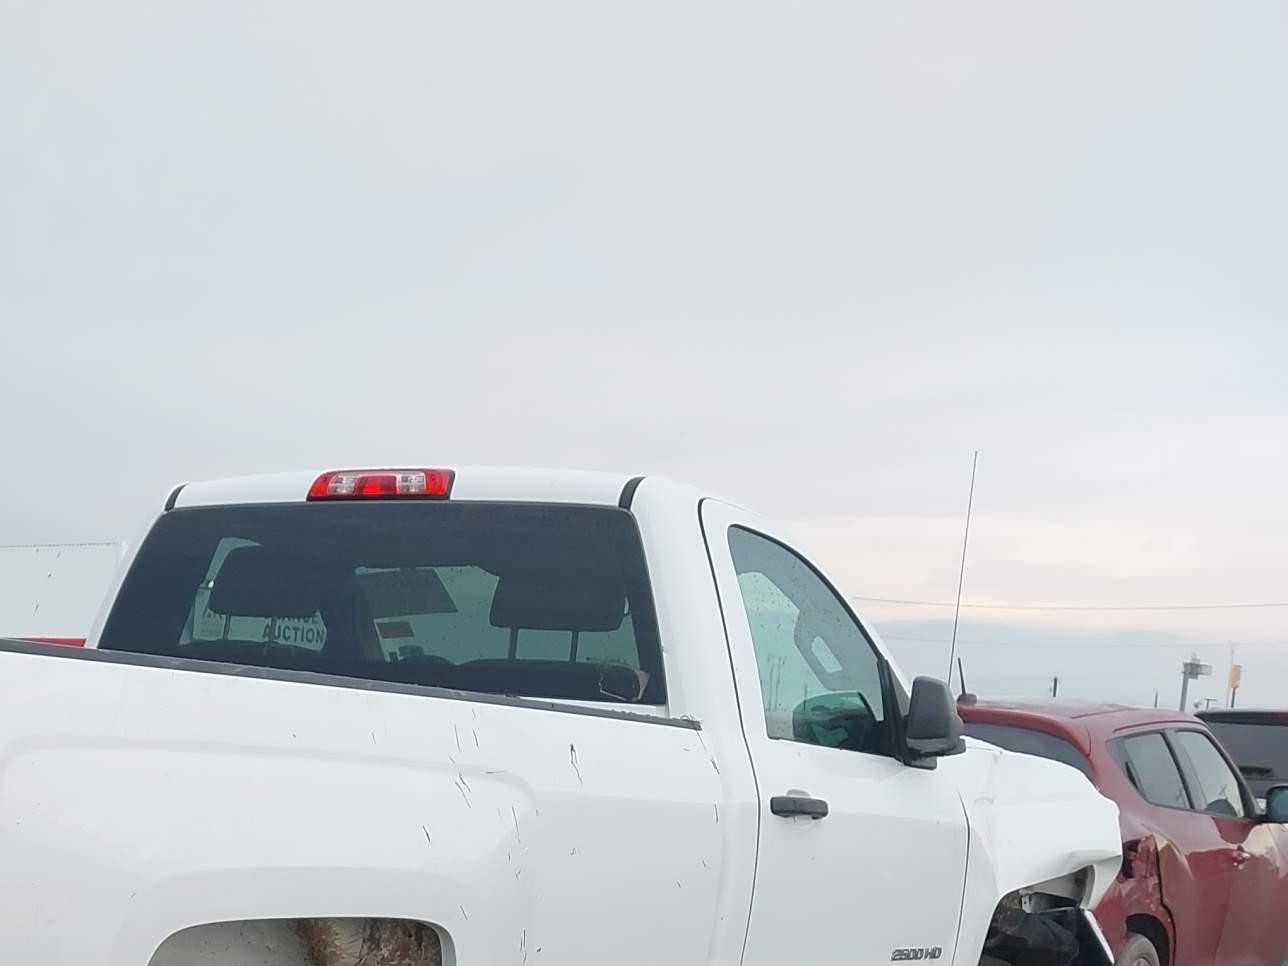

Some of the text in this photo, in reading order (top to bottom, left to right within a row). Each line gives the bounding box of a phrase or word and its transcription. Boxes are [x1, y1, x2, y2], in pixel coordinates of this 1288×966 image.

[262, 622, 325, 644] AUCTION
[891, 946, 942, 961] 2500 HD
